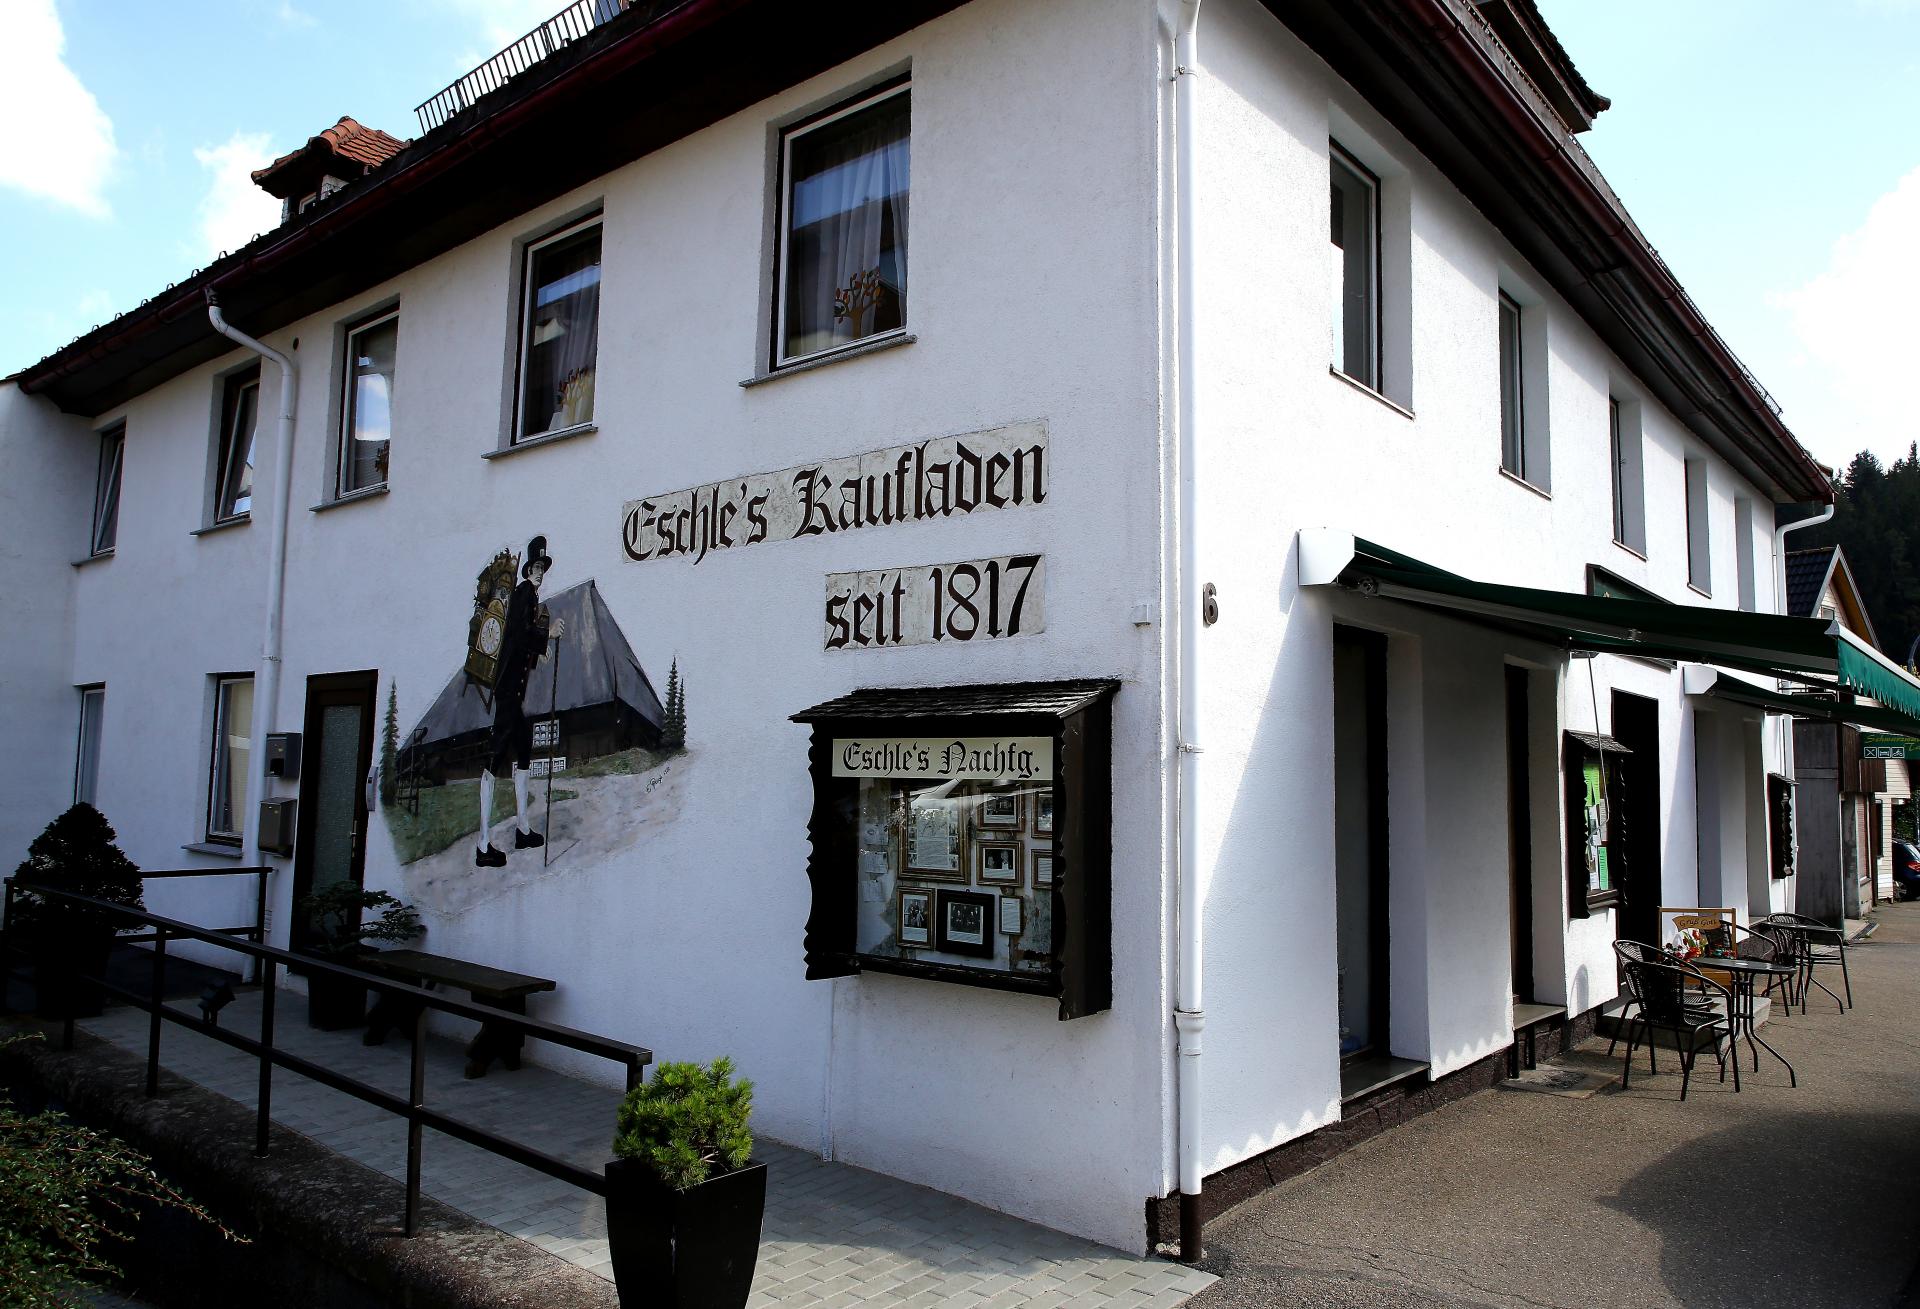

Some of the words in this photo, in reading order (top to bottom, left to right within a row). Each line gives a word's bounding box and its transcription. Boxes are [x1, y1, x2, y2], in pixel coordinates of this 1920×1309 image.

[623, 483, 770, 565] Eschle's
[791, 440, 1047, 538] Kaufladen
[825, 573, 906, 649] seit
[929, 554, 1042, 641] 1817
[937, 740, 1040, 779] Nachfg.
